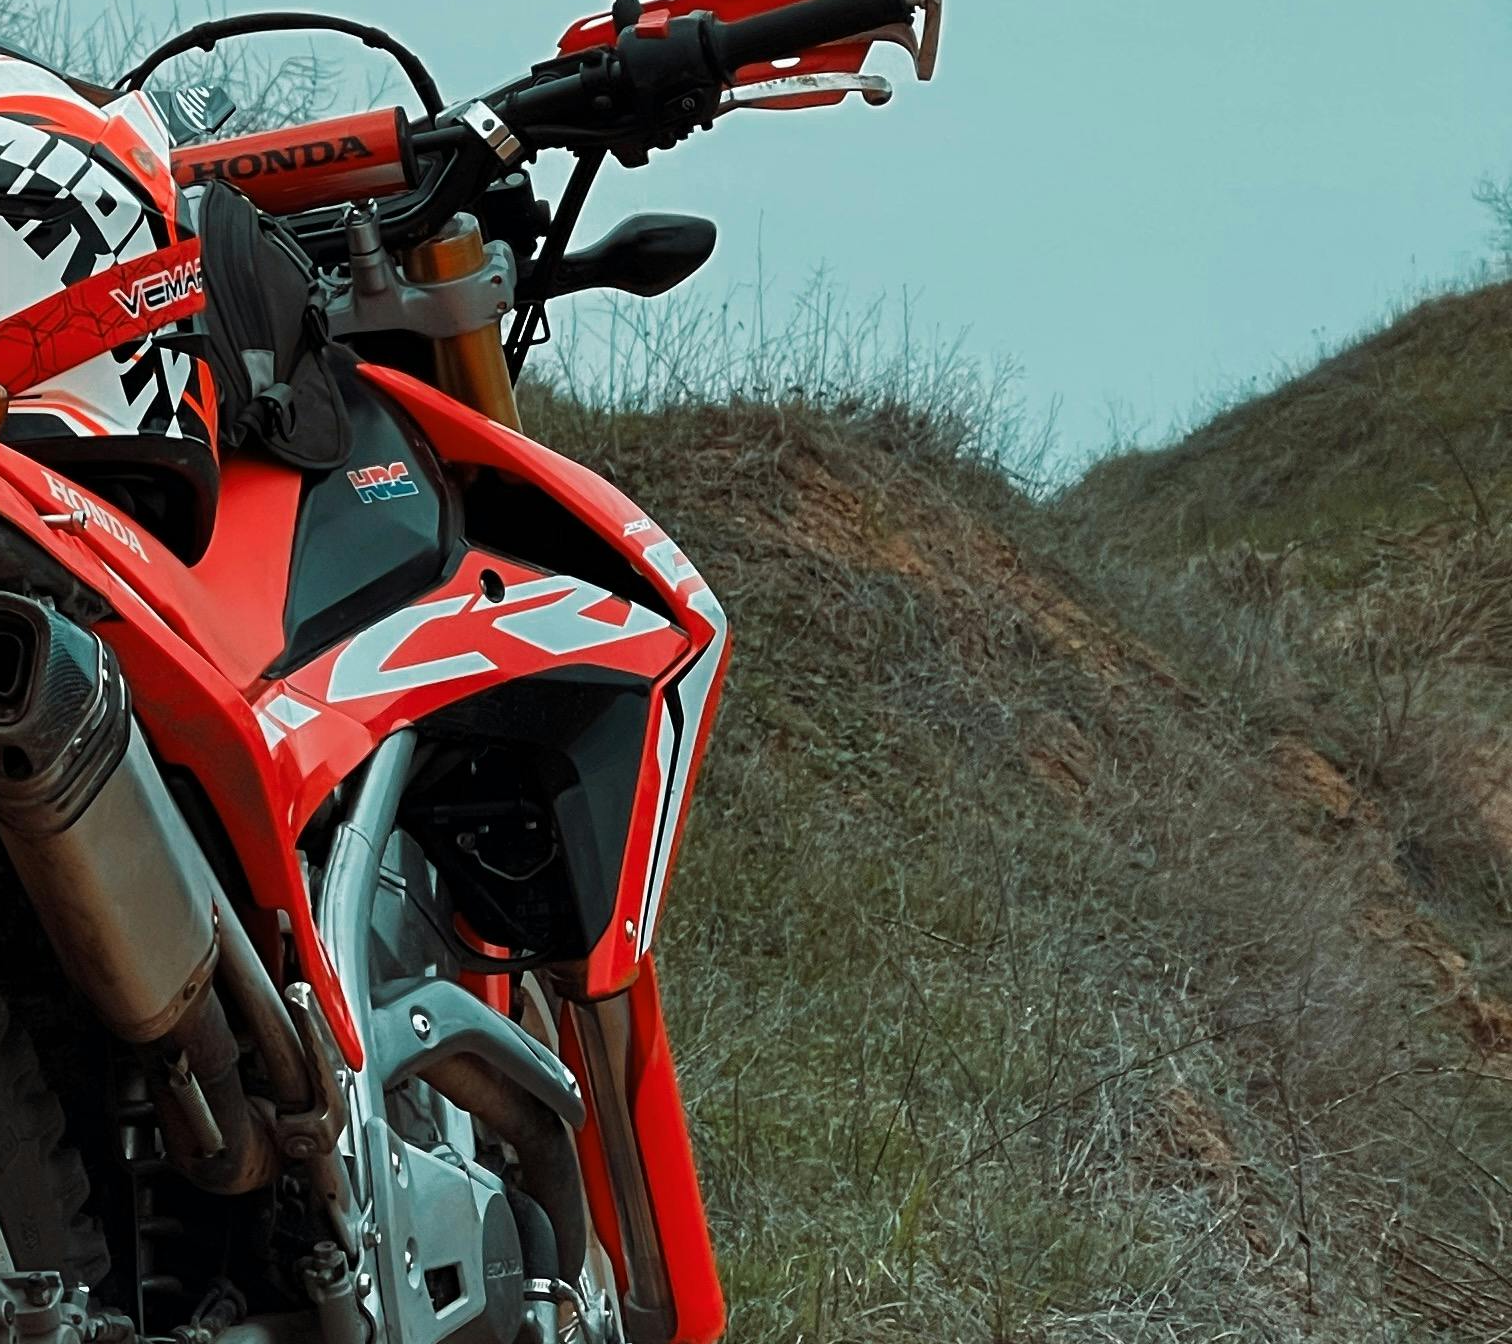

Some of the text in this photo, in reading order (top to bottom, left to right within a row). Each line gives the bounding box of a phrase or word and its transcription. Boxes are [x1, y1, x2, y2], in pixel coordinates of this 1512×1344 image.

[190, 135, 373, 183] HONDA
[346, 461, 420, 504] HRC
[40, 469, 151, 564] HONDA
